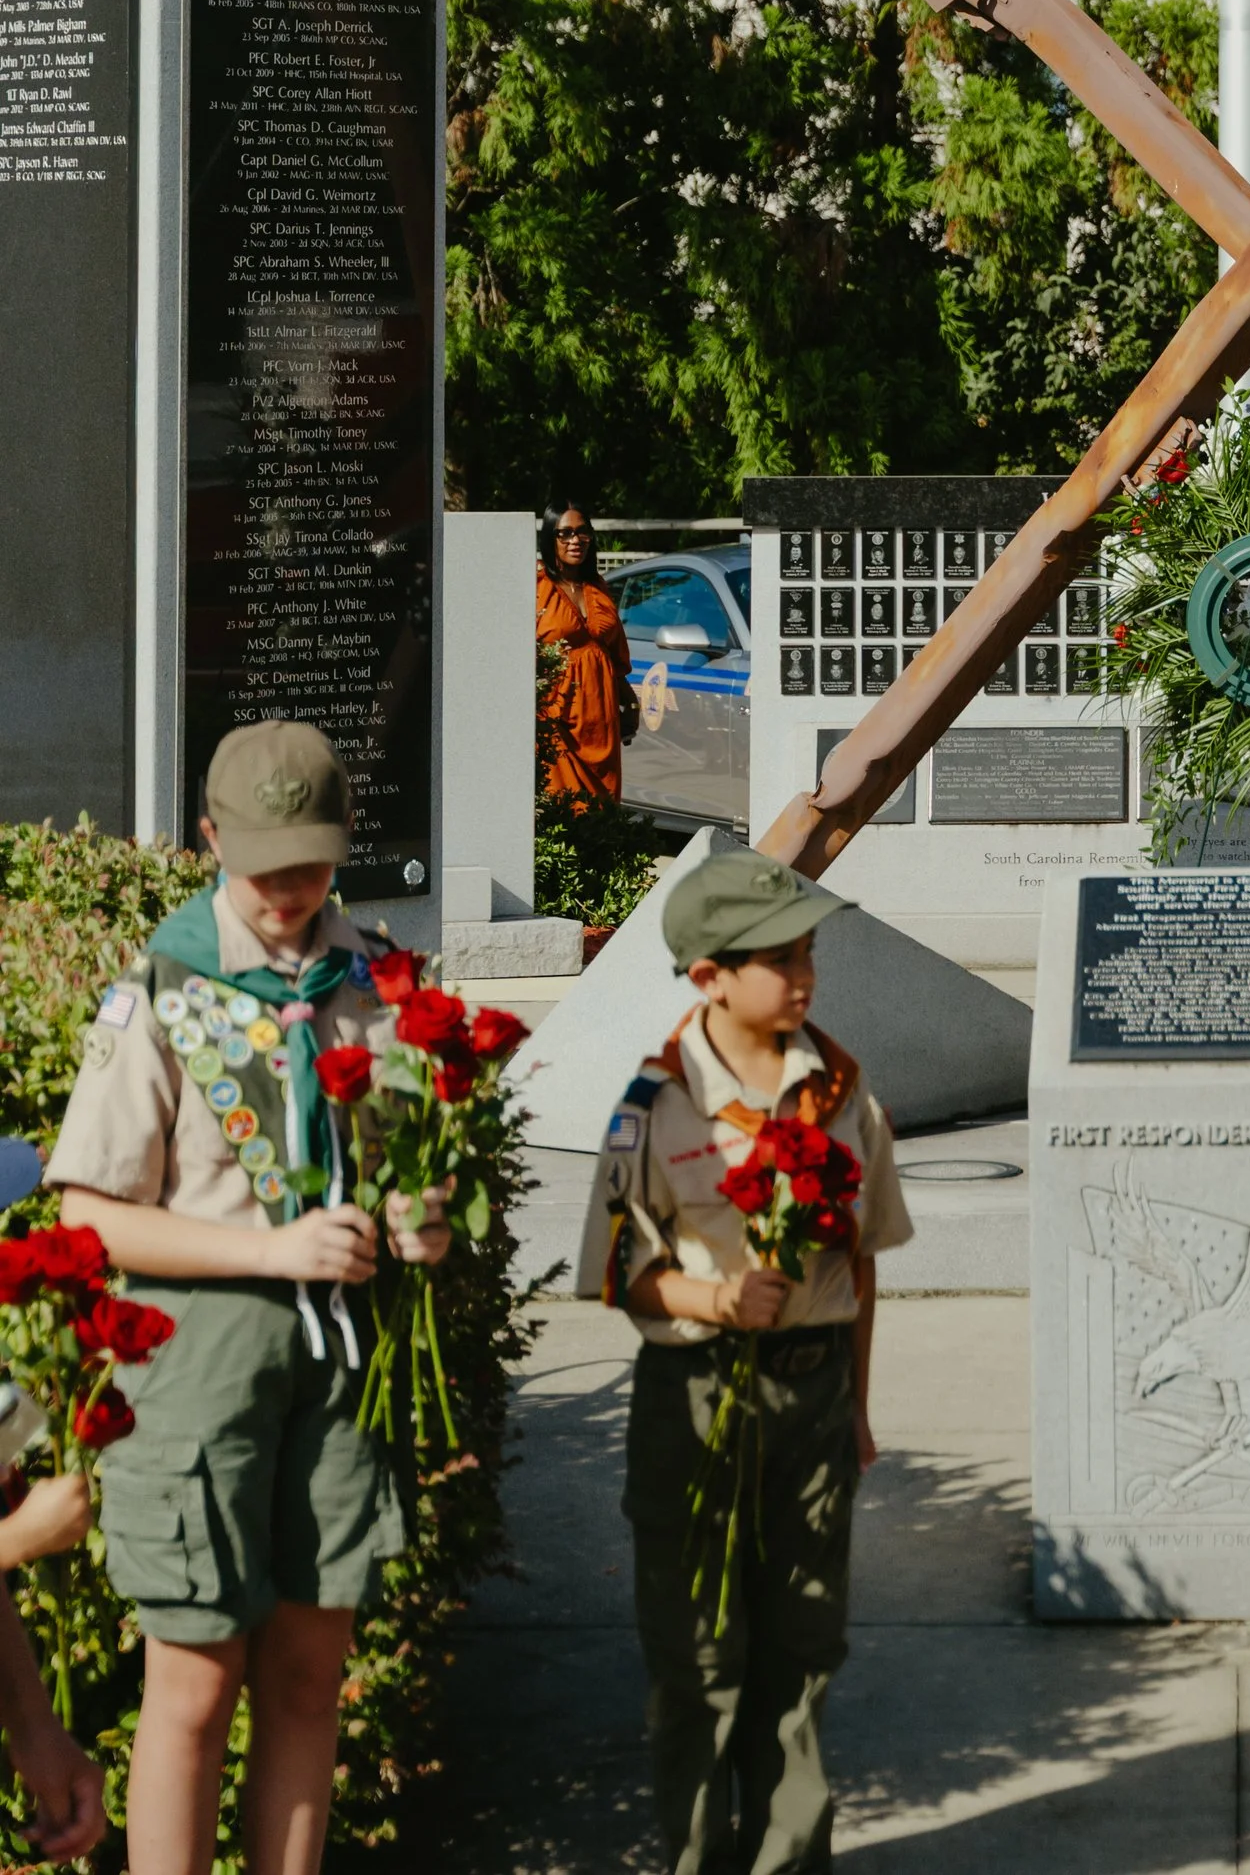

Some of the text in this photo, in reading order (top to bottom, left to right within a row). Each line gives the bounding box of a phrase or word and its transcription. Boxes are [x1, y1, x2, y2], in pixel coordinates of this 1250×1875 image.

[7, 18, 86, 33] Mills Palmer Bigham
[252, 17, 373, 34] SGT A. Joseph Derrick
[248, 51, 375, 69] PFC Robert E. Foster, Jr
[1, 122, 24, 136] James
[26, 121, 55, 134] Edward
[56, 120, 86, 133] Chaffin
[237, 119, 386, 136] SPC Thomas D. Caughman
[240, 153, 382, 168] Capt Daniel G. McCollum
[247, 601, 267, 613] PFC
[272, 600, 318, 615] Anthony
[334, 599, 366, 611] White
[247, 637, 274, 648] MSG
[278, 635, 313, 650] Danny
[331, 633, 370, 648] Maybin
[1229, 839, 1246, 847] are
[984, 852, 1020, 864] South
[1026, 852, 1082, 864] Carolina
[1089, 852, 1146, 865] Rememb
[1218, 848, 1250, 861] watch
[1049, 1127, 1111, 1147] FIRST
